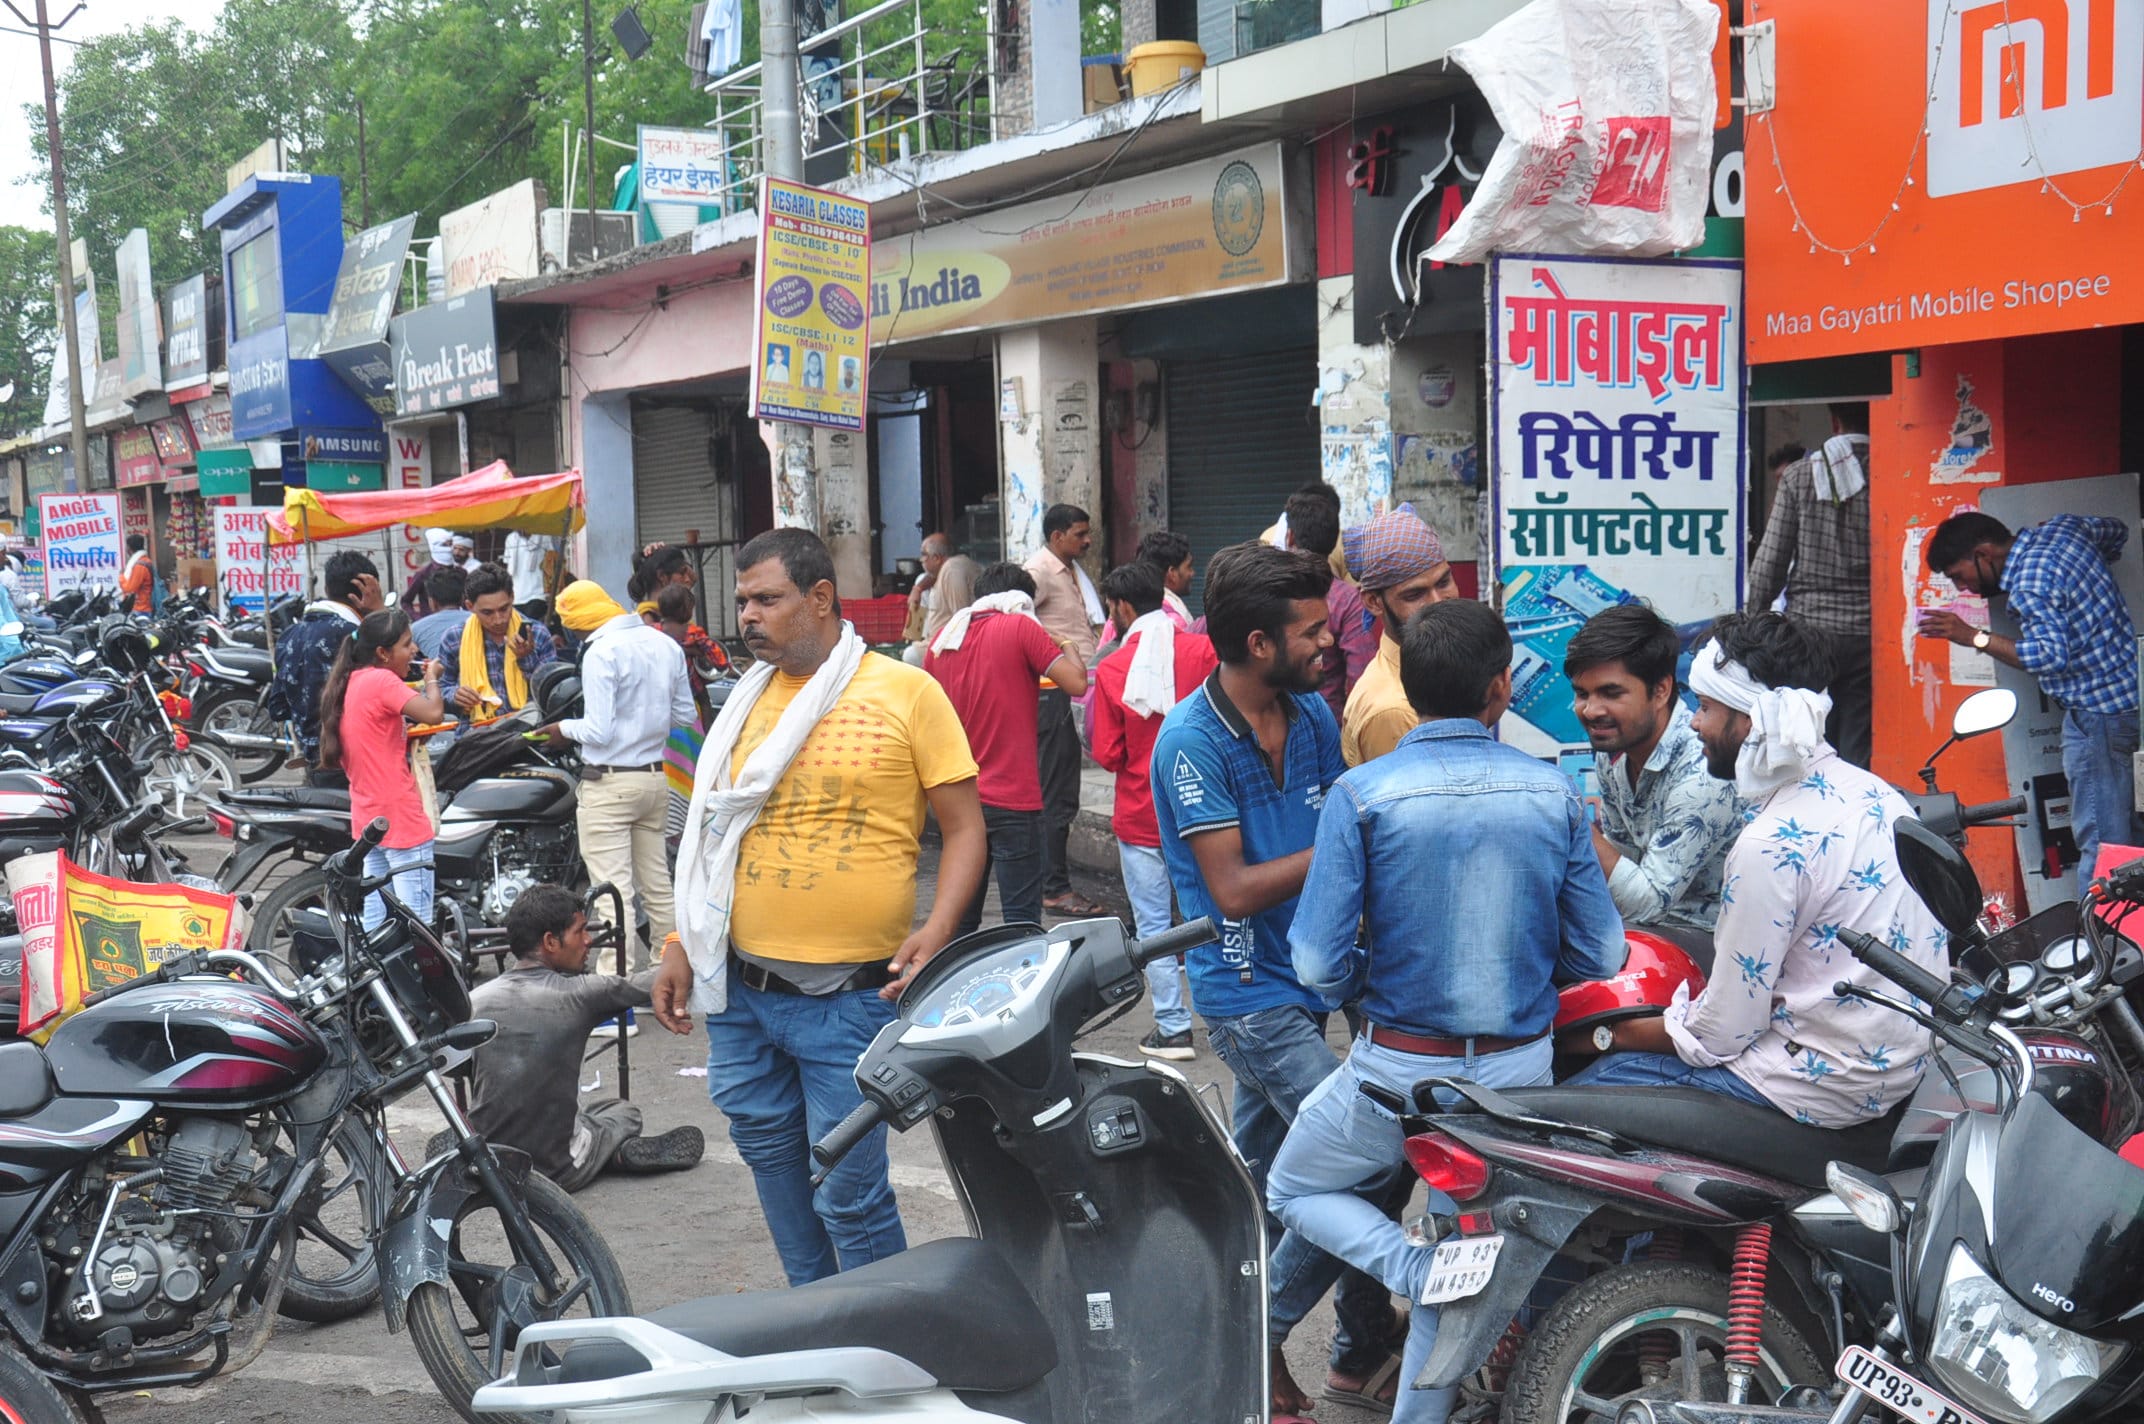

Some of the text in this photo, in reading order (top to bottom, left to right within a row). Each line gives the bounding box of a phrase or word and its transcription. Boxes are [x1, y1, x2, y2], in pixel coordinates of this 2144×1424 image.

[771, 189, 865, 229] KESARIA CLASSES
[899, 268, 982, 312] India
[1766, 274, 2110, 337] Maa Gayatri Mobile Shopee
[1506, 267, 1731, 404] मोबाइल
[405, 346, 454, 391] Break
[455, 341, 494, 379] Fast
[308, 436, 382, 453] AMSUNG
[1518, 411, 1720, 481] रिपेरिंग
[48, 498, 104, 519] ANGEL
[46, 517, 115, 541] MOBILE
[1508, 492, 1729, 557] सॉफ्टवेयर
[48, 547, 118, 570] रिपेयरिंग
[226, 535, 298, 565] मोबइल
[43, 784, 68, 795] Hero
[147, 946, 164, 964] जय
[150, 999, 265, 1015] Discover
[1443, 1243, 1491, 1267] UP 93
[2032, 1282, 2075, 1313] Hero
[1849, 1354, 1914, 1407] UP93
